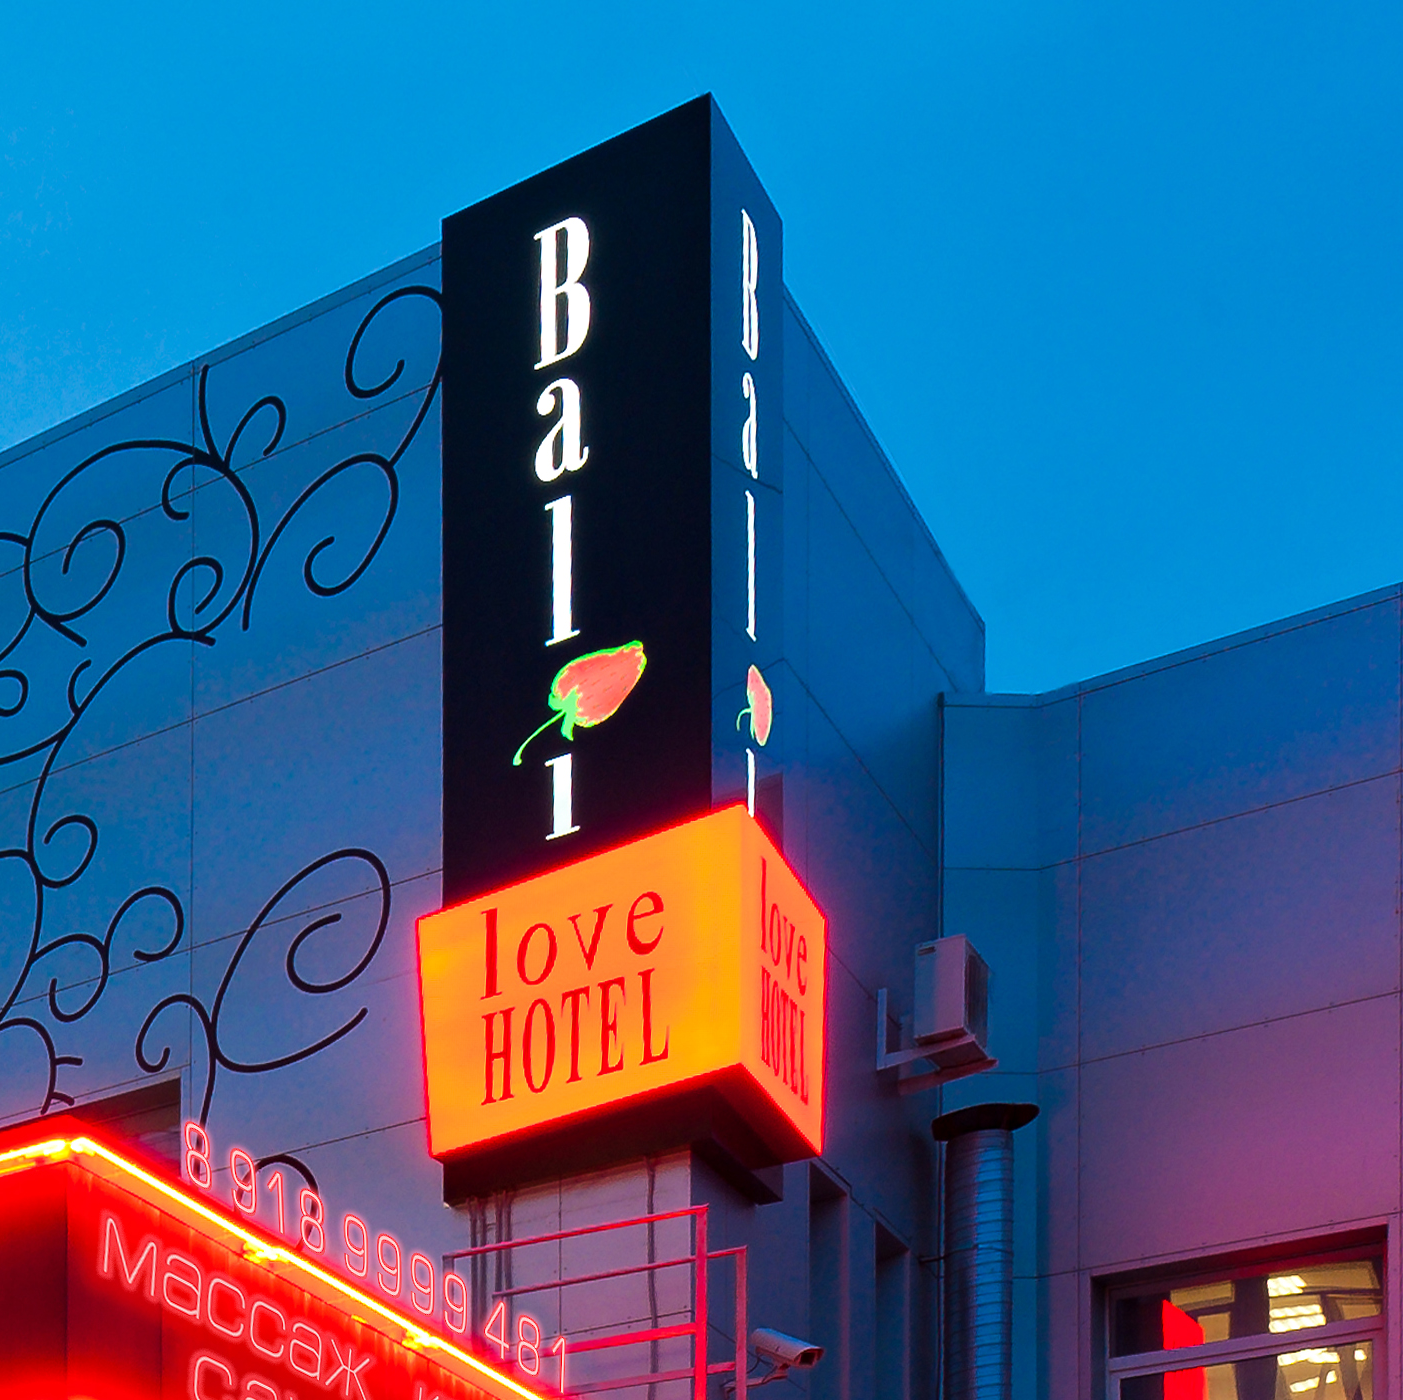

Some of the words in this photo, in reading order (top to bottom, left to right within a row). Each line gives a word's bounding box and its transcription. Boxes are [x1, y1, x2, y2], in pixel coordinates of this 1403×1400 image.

[533, 215, 592, 841] Bali
[480, 890, 665, 1001] love
[760, 855, 808, 997] love
[480, 967, 671, 1106] HOTEL
[760, 964, 809, 1106] HOTEL
[183, 1120, 212, 1189] 8
[229, 1147, 325, 1253] 918
[342, 1212, 469, 1334] 9999
[483, 1300, 568, 1394] 481
